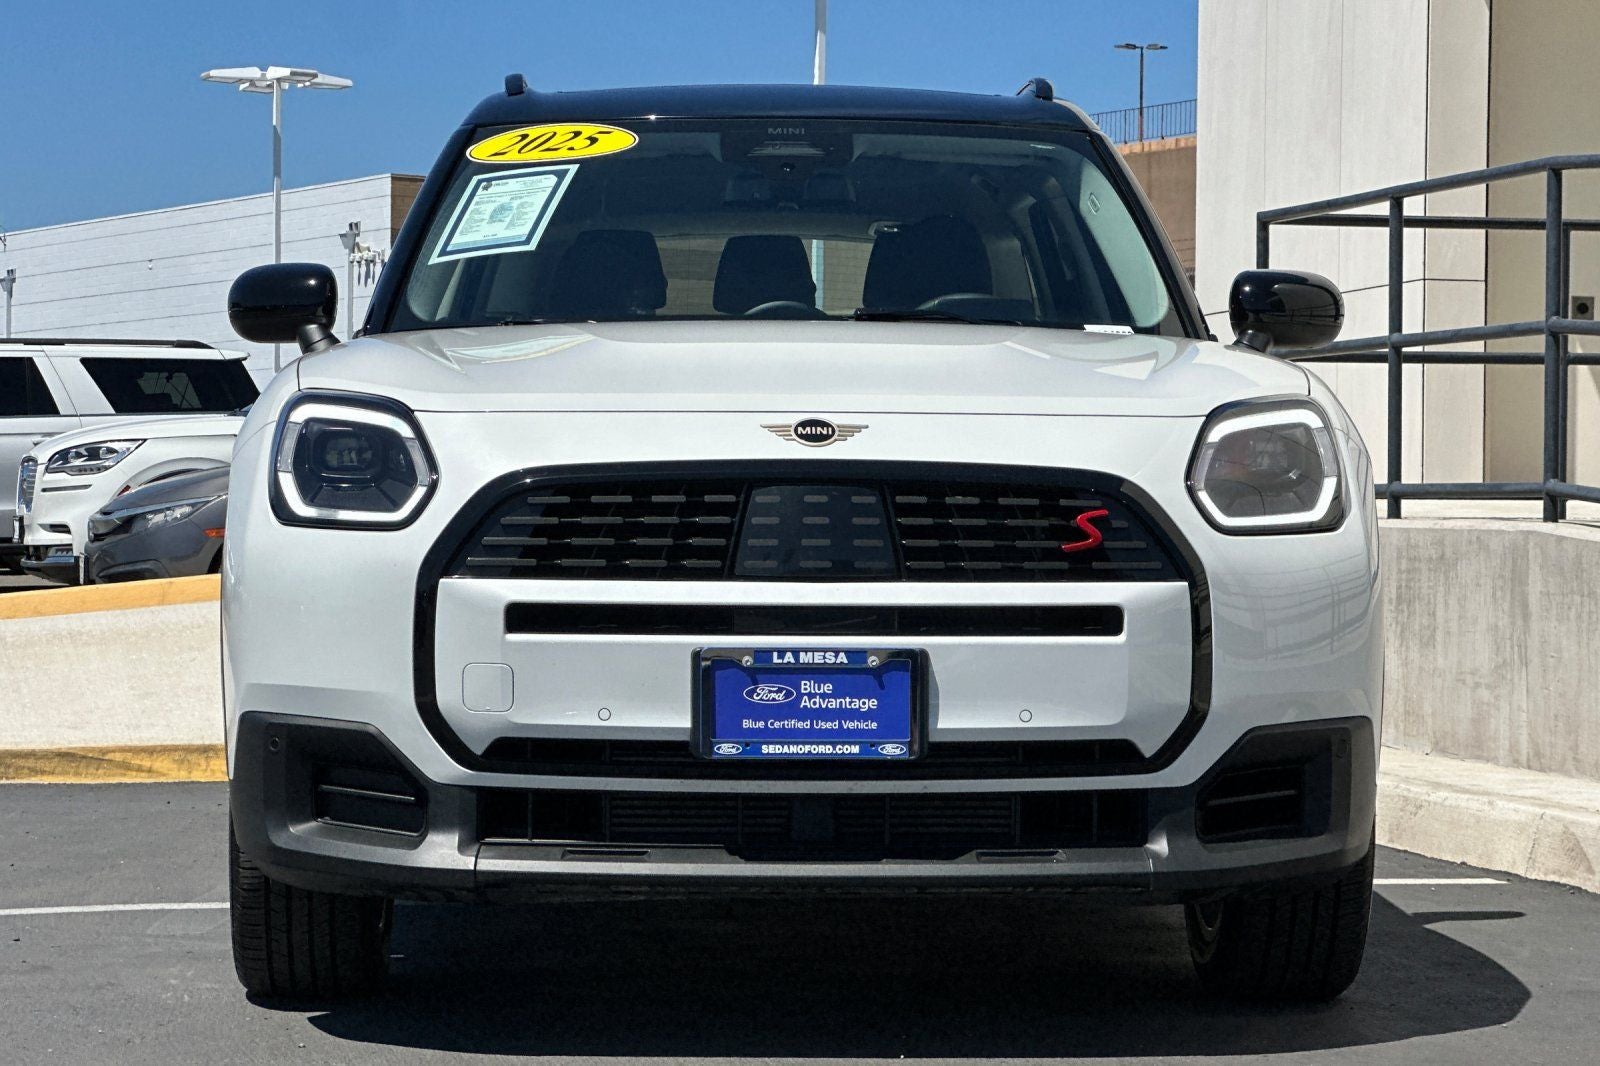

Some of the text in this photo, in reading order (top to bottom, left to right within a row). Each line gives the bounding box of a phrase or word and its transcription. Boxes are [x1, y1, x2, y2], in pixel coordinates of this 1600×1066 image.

[487, 130, 613, 157] 2025
[797, 426, 832, 435] MINI
[1061, 508, 1109, 553] S
[772, 652, 848, 664] LA MESA
[800, 680, 832, 693] Blue
[753, 687, 786, 701] Ford
[800, 696, 877, 711] Advantage
[742, 719, 877, 729] Blue Certified Used Vehicle
[761, 745, 860, 754] SEDANOFORD.COM
